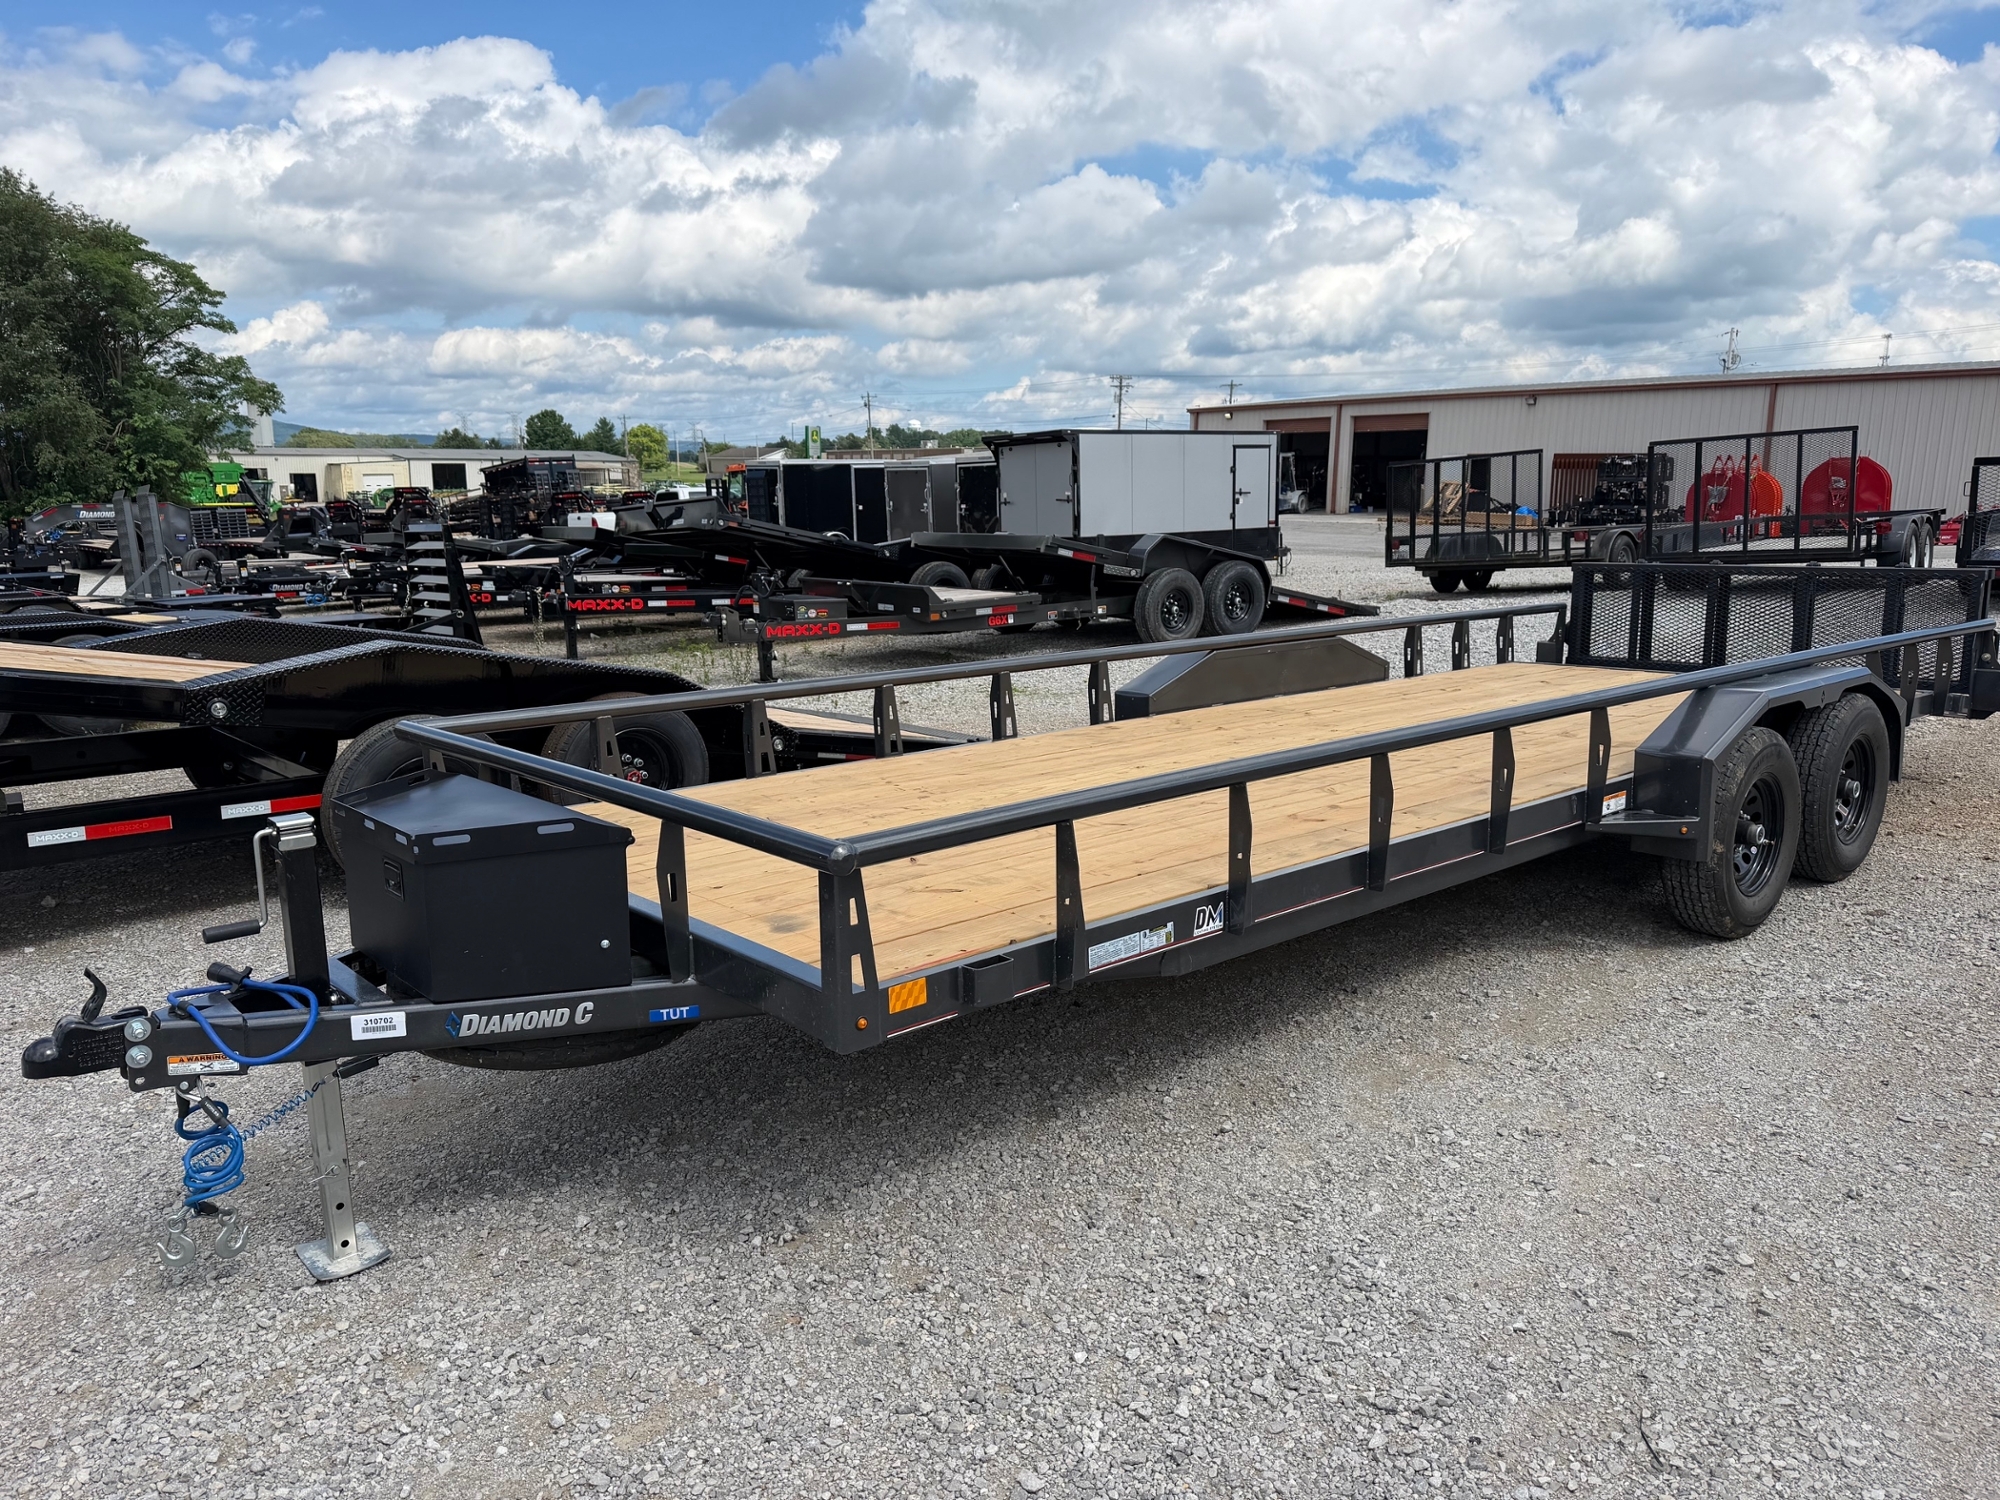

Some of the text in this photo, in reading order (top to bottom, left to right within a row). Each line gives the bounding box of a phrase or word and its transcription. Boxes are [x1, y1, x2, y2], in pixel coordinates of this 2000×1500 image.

[79, 510, 115, 518] DIAMOND
[272, 584, 304, 592] DIAMOND
[568, 598, 644, 611] MAXX-D
[988, 615, 1008, 626] G6X
[766, 622, 841, 638] MAXX-D
[458, 1001, 595, 1038] DIAMOND C
[660, 1007, 691, 1021] TUT
[363, 1016, 394, 1026] 310702
